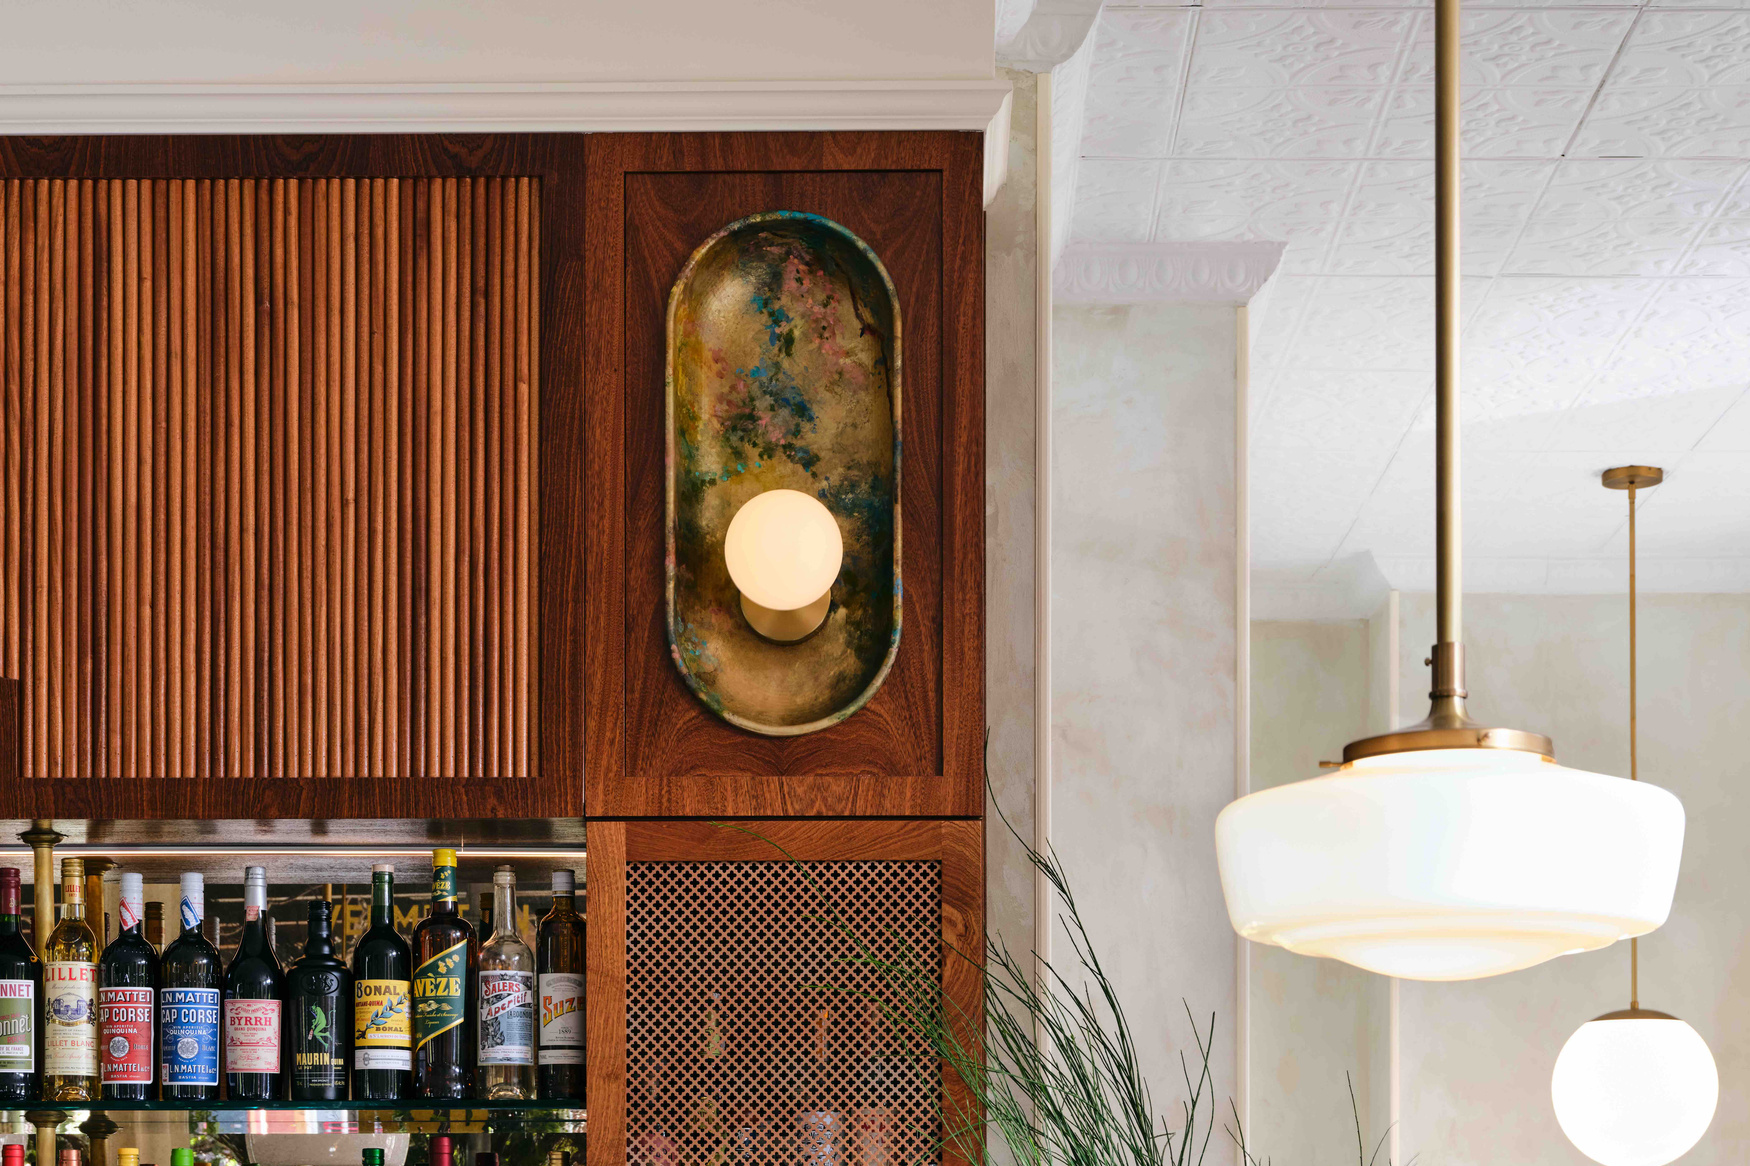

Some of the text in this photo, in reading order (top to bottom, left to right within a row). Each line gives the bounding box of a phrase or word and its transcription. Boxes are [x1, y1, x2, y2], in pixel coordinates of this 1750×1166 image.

[45, 967, 97, 982] LILLET
[356, 982, 400, 999] BONAL
[484, 980, 521, 997] SALERS
[113, 1008, 150, 1022] CORSE
[181, 1009, 217, 1023] CORSE
[230, 1016, 272, 1026] BYRRH
[296, 1053, 330, 1065] MAURIN
